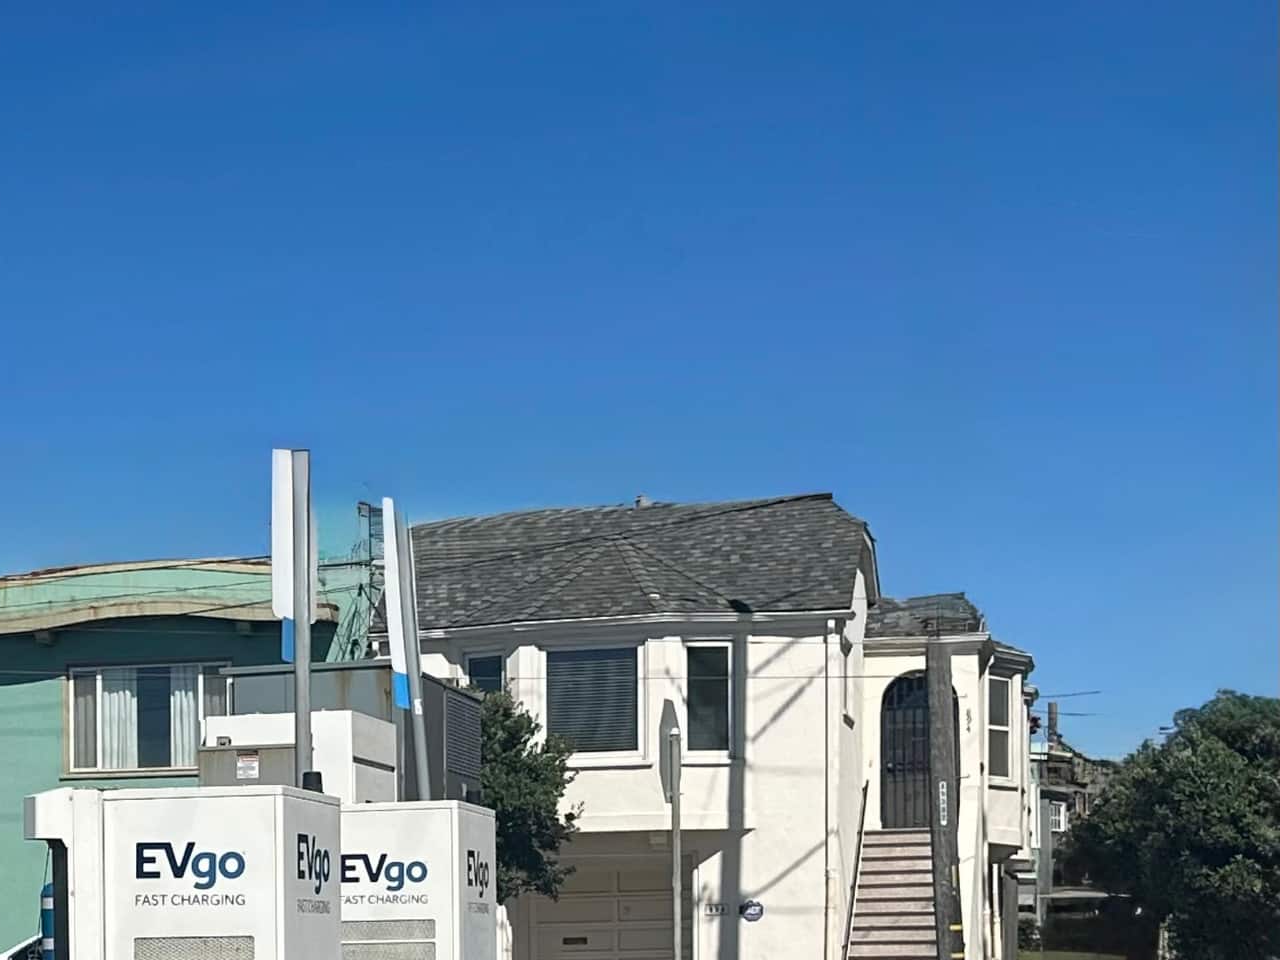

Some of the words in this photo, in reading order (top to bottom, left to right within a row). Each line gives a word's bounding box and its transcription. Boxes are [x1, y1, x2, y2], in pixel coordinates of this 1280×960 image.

[135, 841, 246, 890] EVgo
[297, 832, 330, 895] EVgo
[340, 853, 428, 892] EVgo
[467, 850, 490, 898] EVgo
[135, 894, 168, 907] FAST
[170, 893, 246, 906] CHARGING
[367, 894, 429, 905] CHARGING
